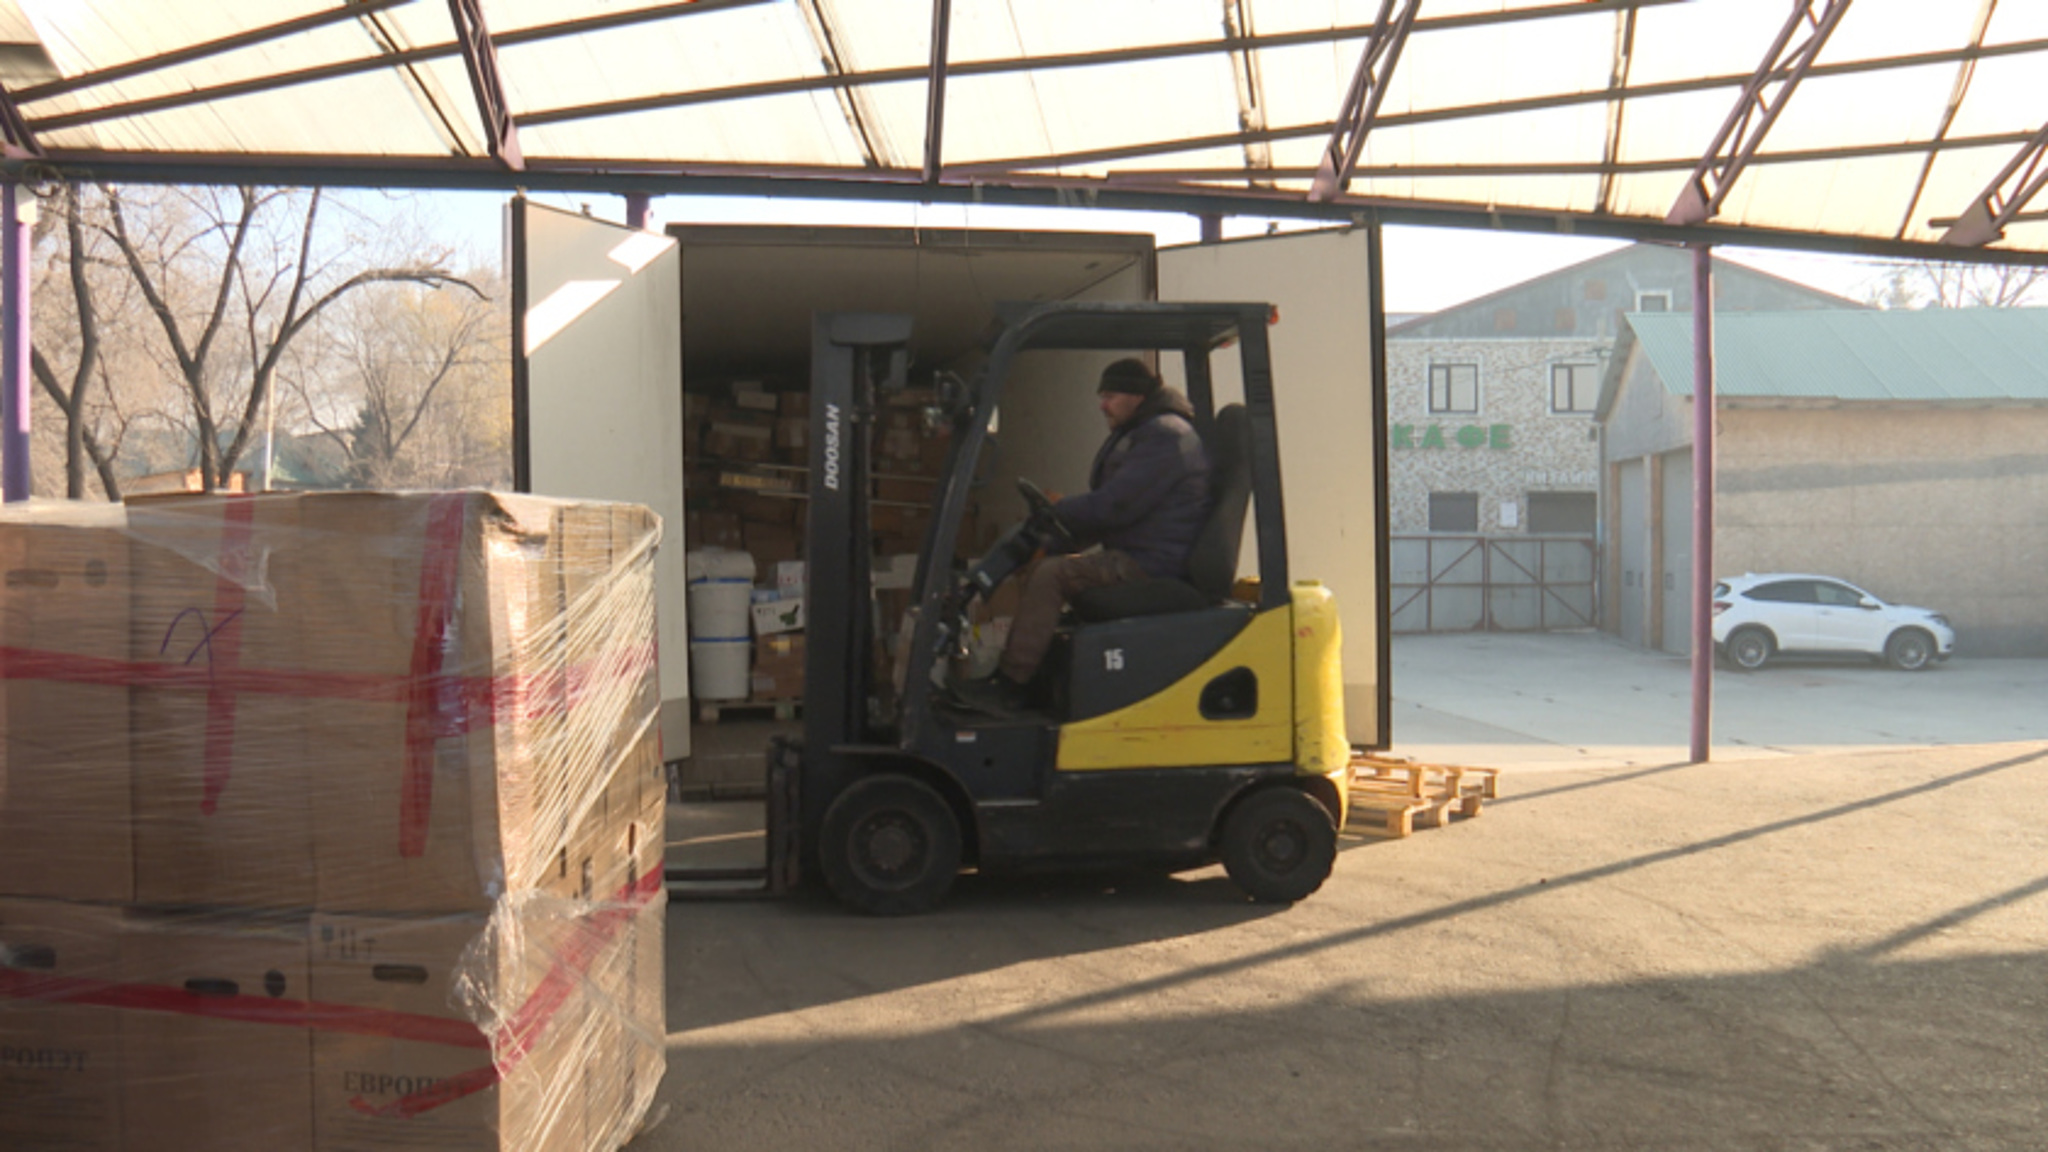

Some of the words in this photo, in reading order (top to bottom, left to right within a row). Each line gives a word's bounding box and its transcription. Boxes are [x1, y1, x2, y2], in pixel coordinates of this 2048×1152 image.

[824, 403, 839, 490] DOOSAN
[1392, 424, 1512, 449] КАФЕ
[1104, 648, 1125, 670] 15
